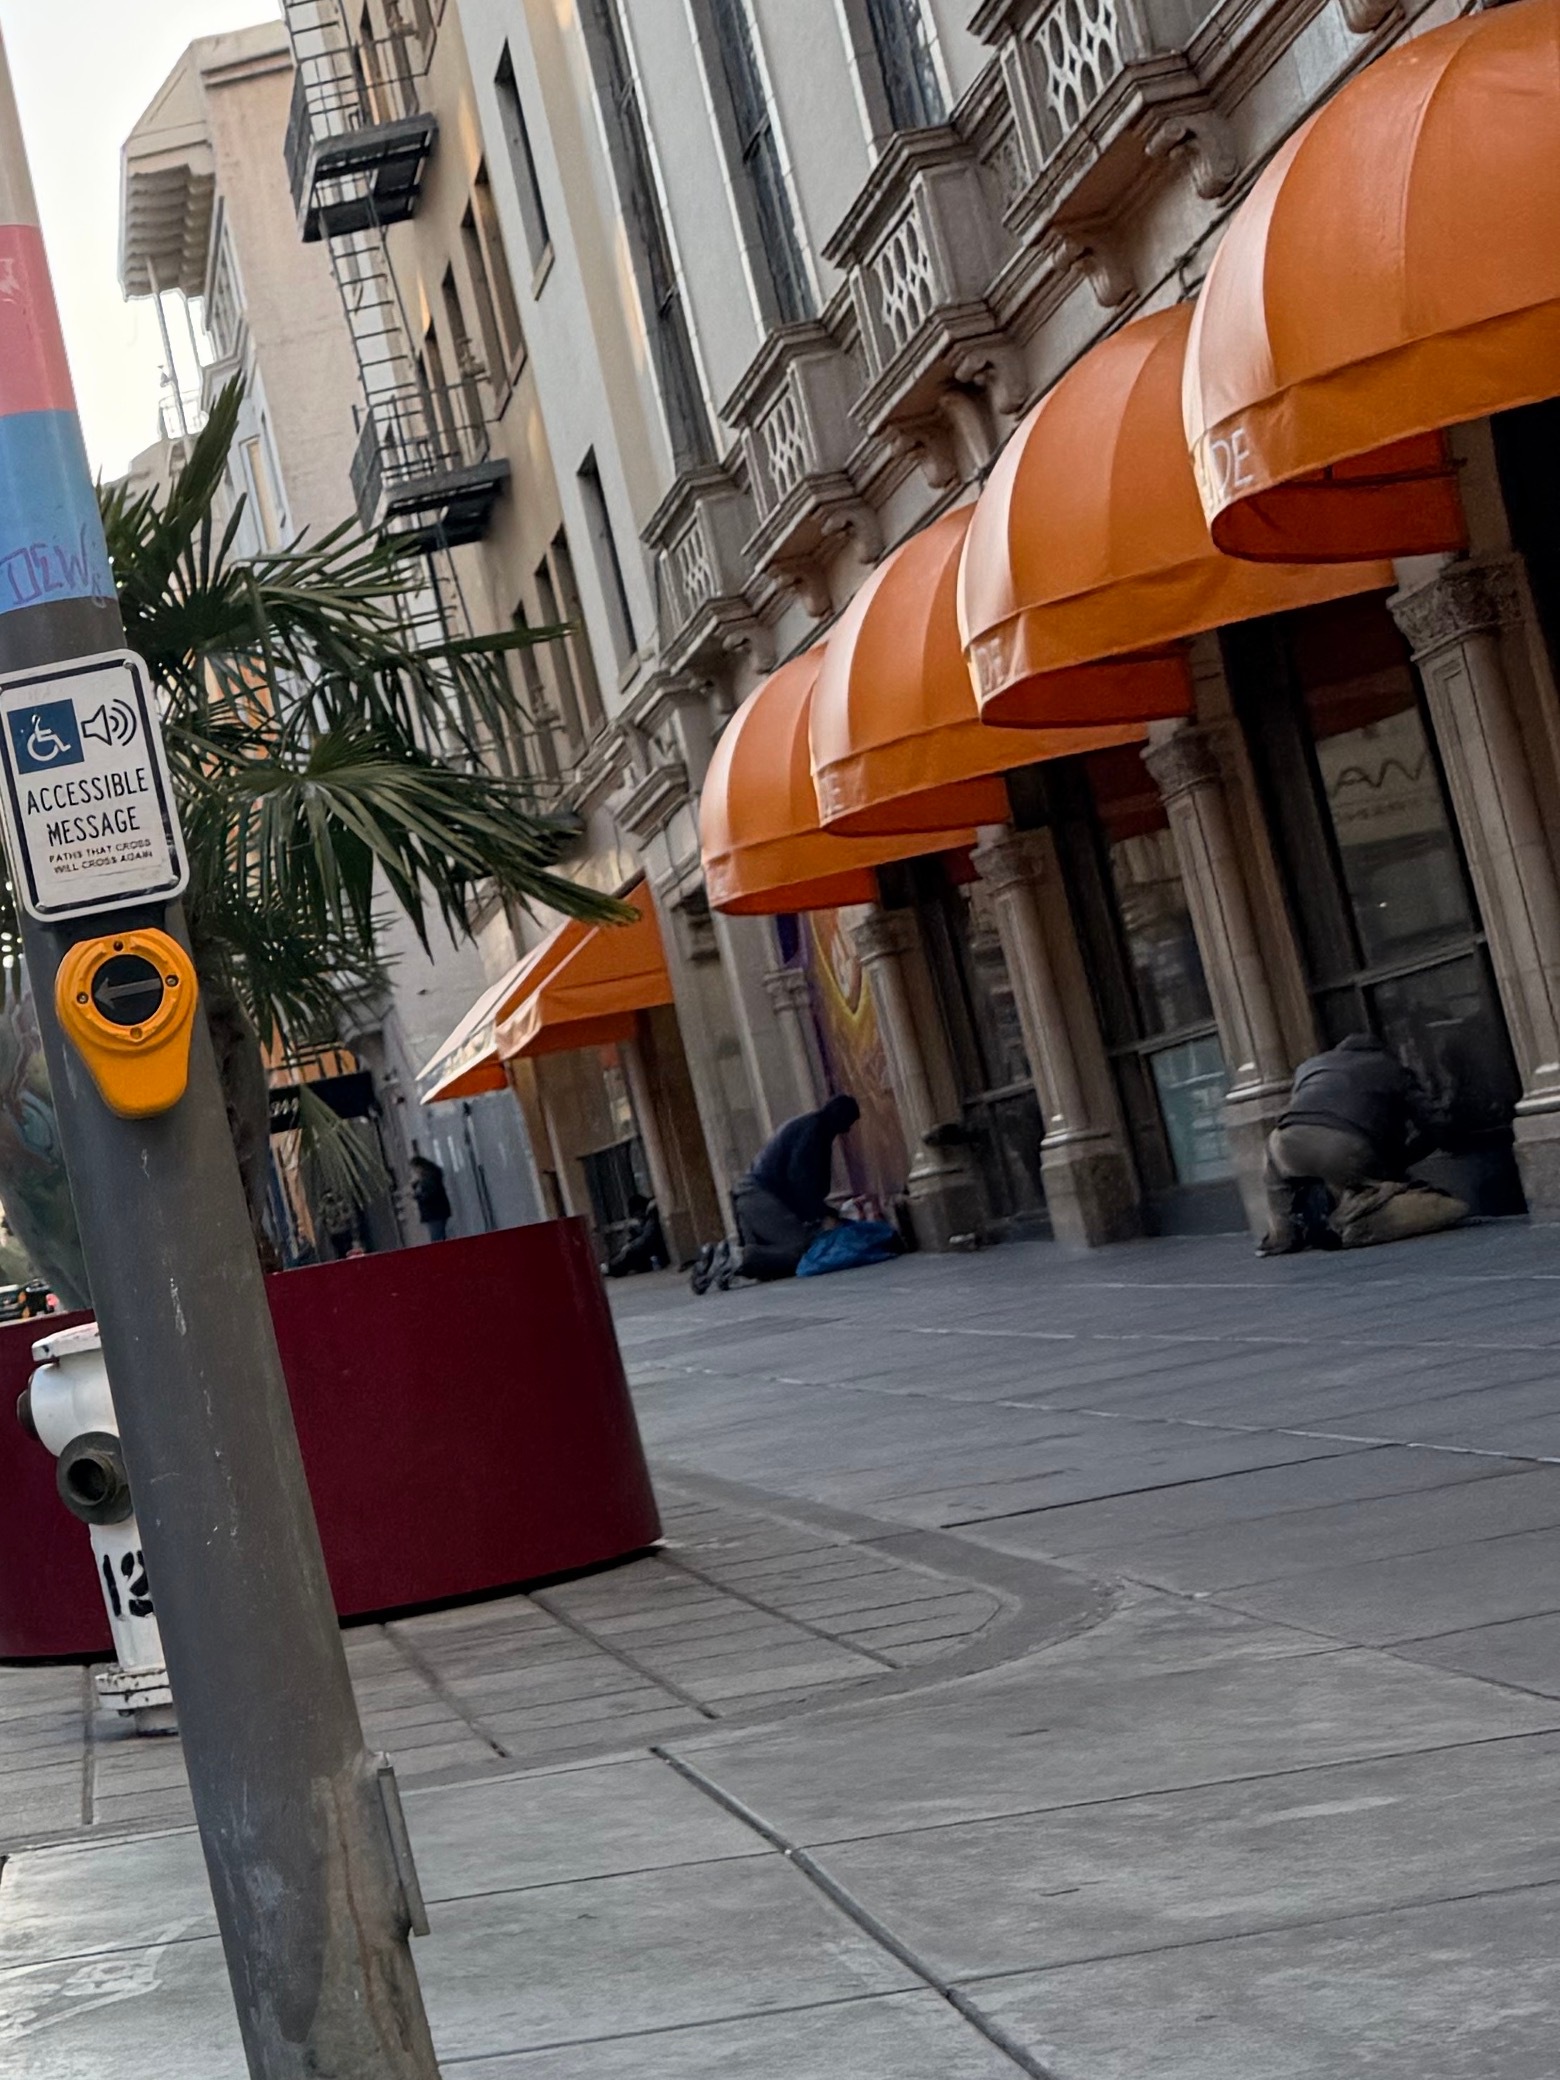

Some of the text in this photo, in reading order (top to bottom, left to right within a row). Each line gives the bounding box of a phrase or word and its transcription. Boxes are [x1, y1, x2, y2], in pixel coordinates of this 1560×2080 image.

[27, 768, 149, 815] ACCESSIBLE
[46, 806, 140, 847] MESSAGE
[86, 845, 113, 856] THAT
